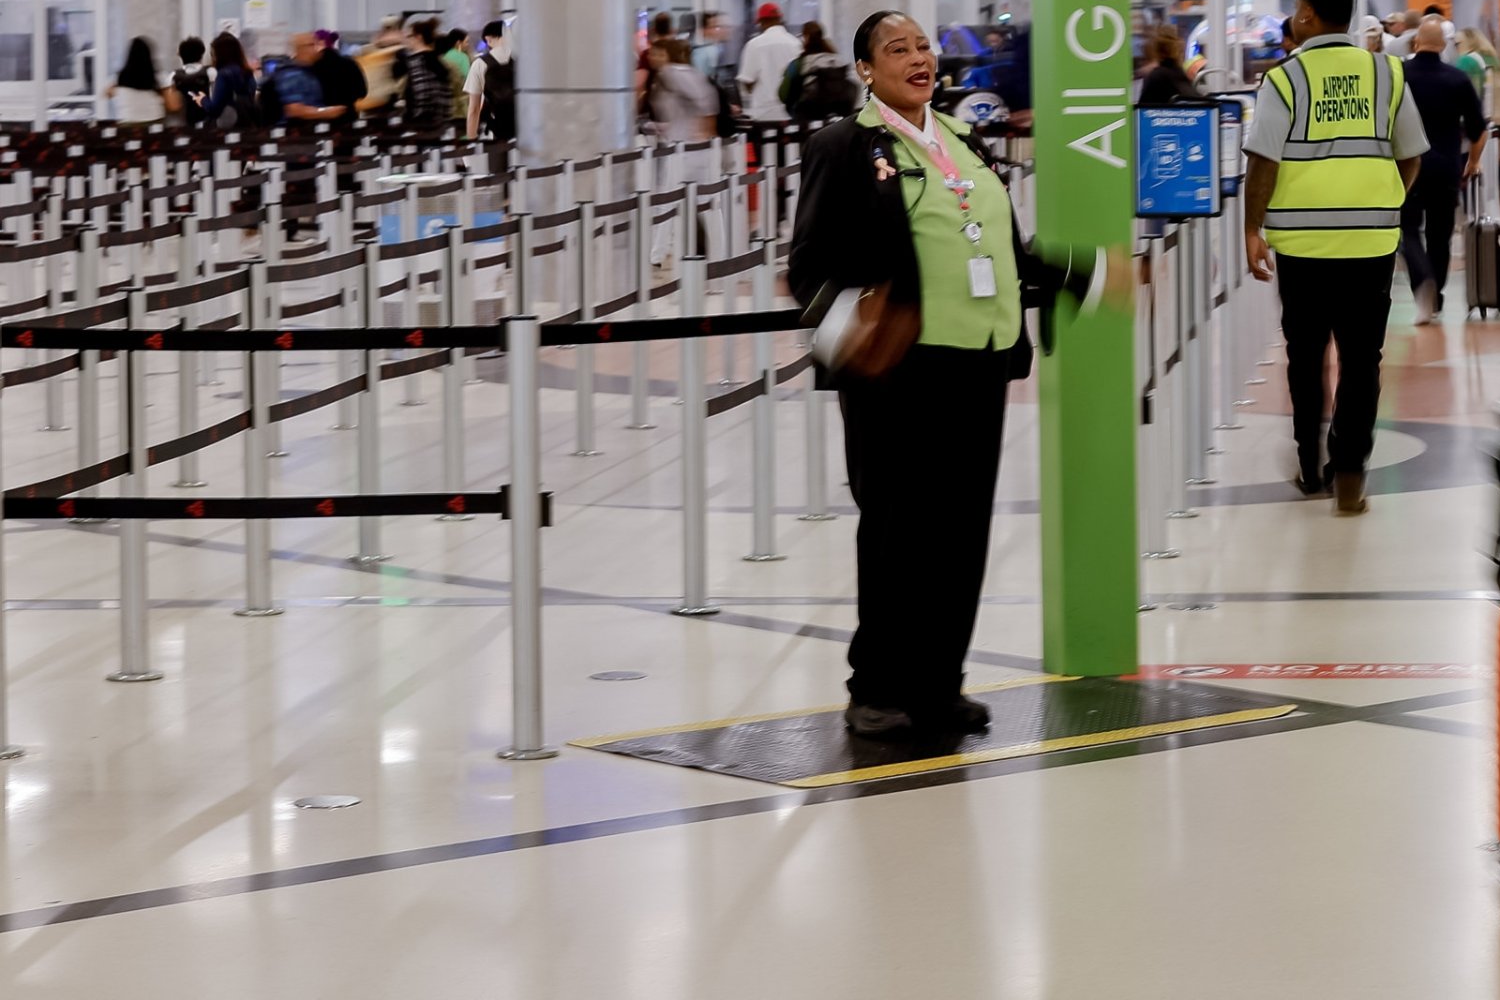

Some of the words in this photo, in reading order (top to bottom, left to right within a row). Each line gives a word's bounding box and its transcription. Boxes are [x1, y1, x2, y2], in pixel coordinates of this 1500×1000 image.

[1323, 74, 1361, 99] AIRPORT
[1315, 97, 1370, 124] OPERATIONS
[1061, 87, 1127, 168] All
